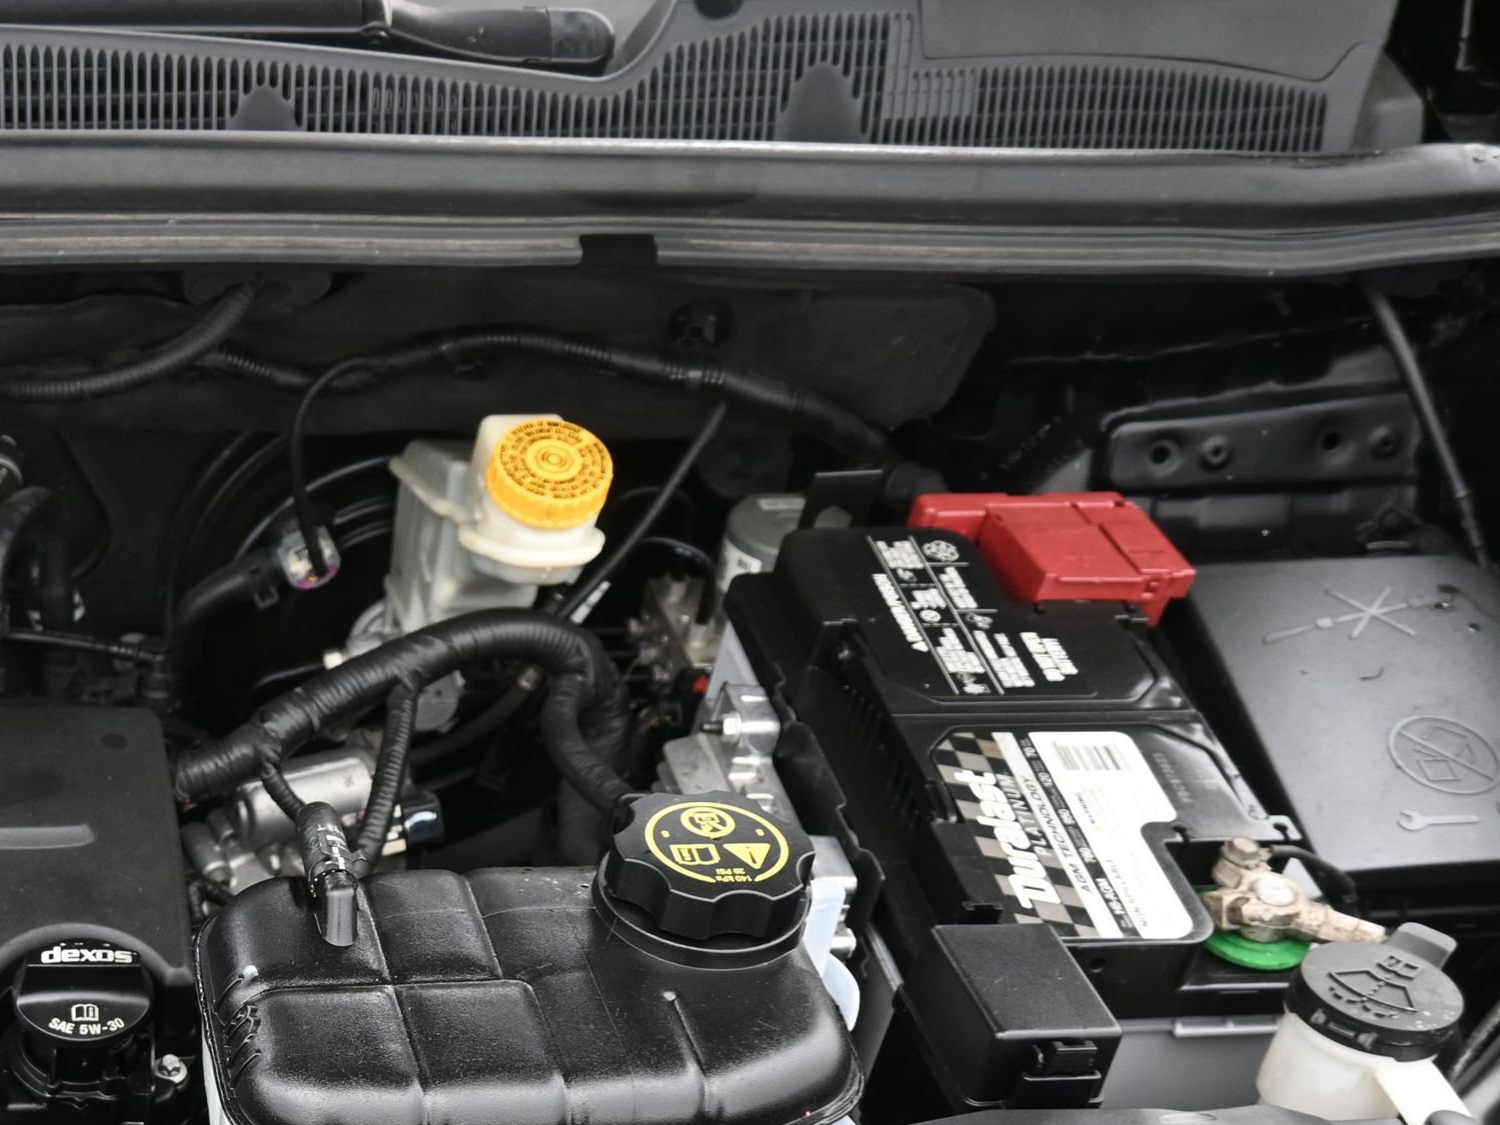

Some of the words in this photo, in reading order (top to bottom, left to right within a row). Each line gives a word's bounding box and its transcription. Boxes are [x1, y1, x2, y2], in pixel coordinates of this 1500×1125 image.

[954, 770, 1061, 909] Duralast
[996, 773, 1053, 857] PLATINUM
[1020, 774, 1072, 858] TECHNOLOGY
[1068, 863, 1093, 893] AGM
[41, 946, 133, 964] dexos
[48, 1017, 75, 1035] SAE
[79, 1017, 125, 1035] 5W-30
